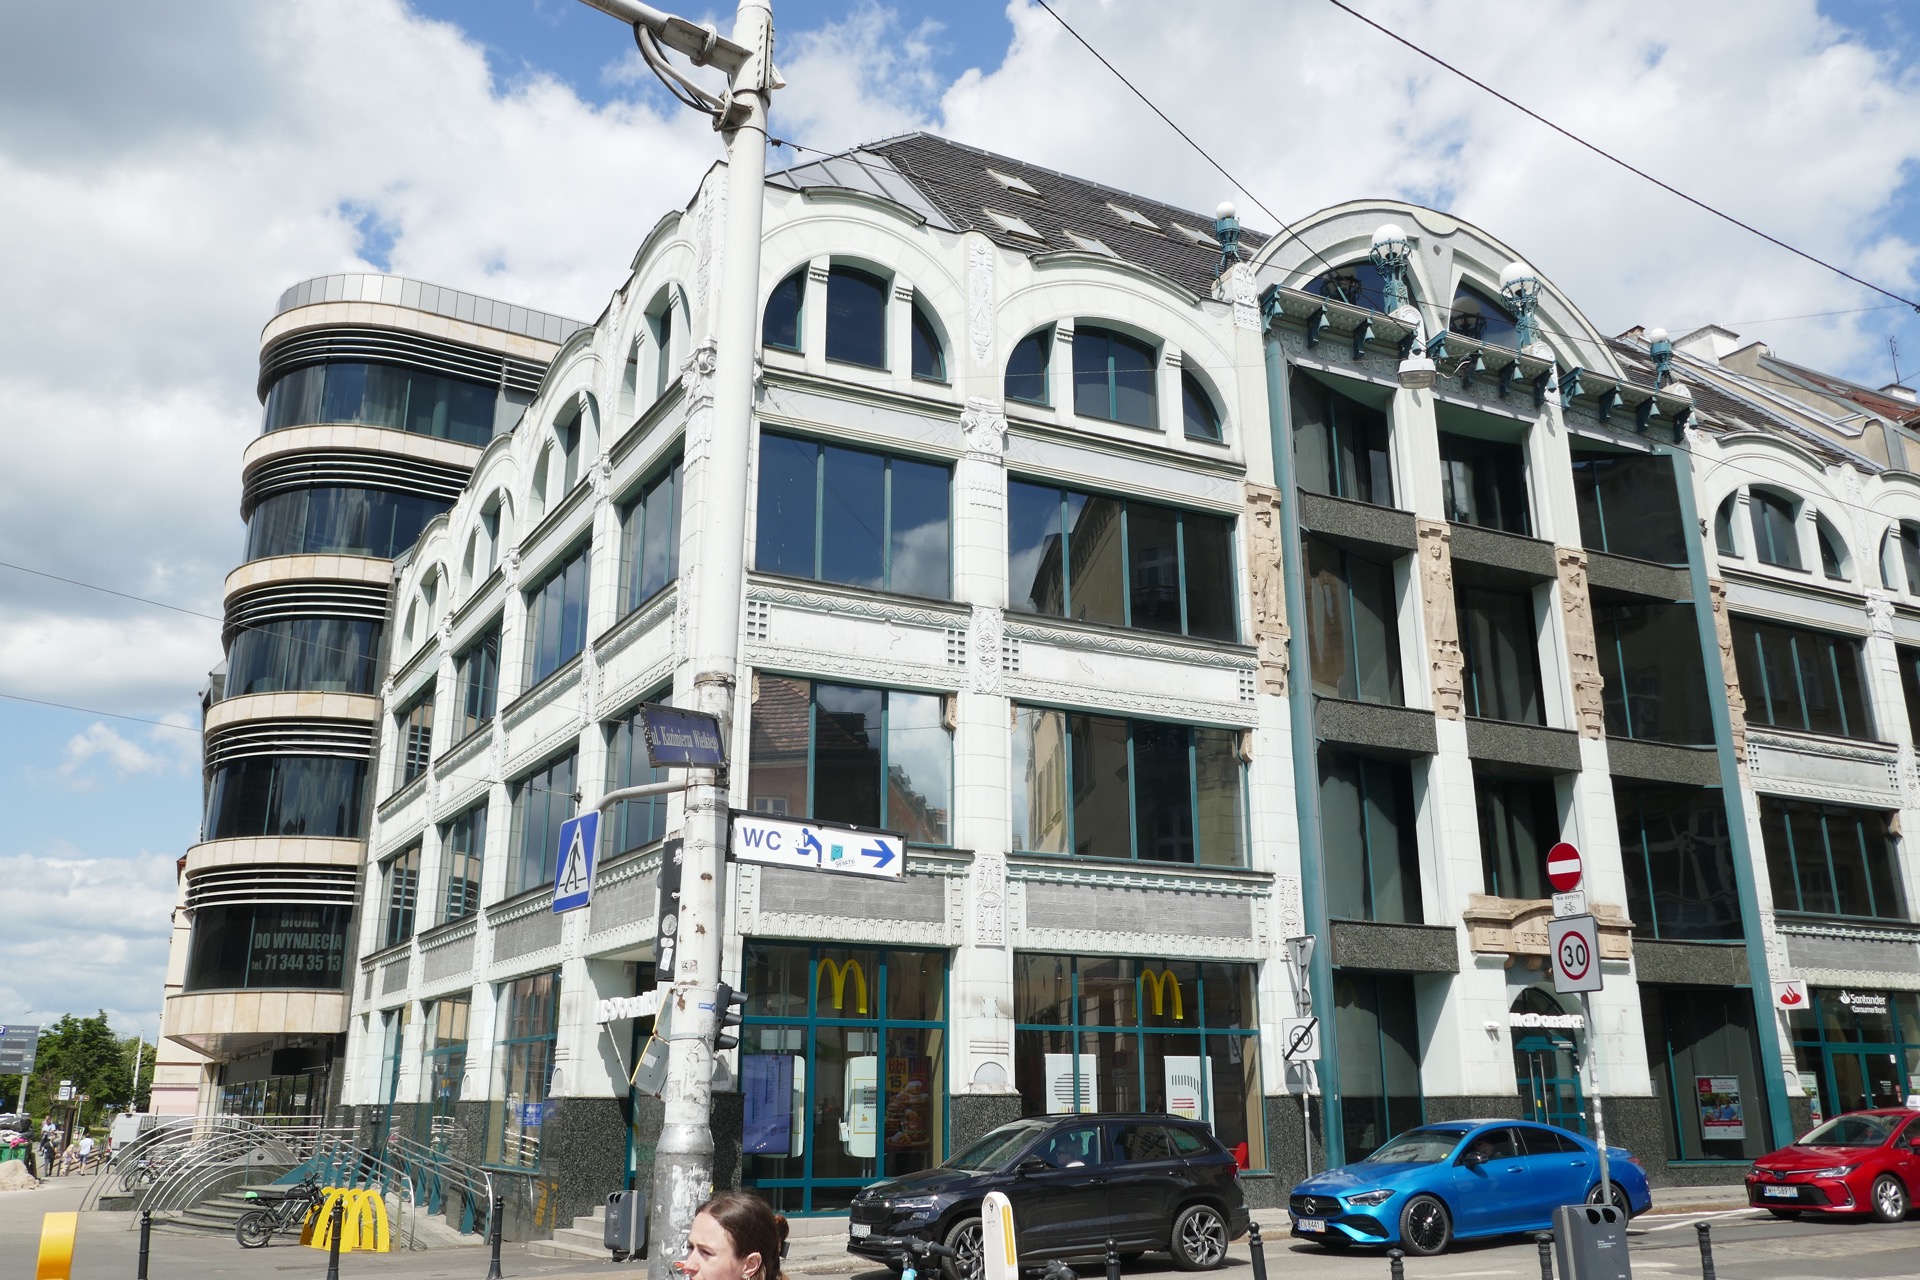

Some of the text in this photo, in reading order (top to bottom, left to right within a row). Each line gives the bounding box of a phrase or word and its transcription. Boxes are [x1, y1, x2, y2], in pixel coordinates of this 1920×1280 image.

[651, 726, 719, 754] ul. Kazimierza Wielkiego
[743, 826, 782, 850] WC
[281, 912, 319, 928] BIURA
[254, 933, 343, 952] DO WYNAJĘCIA
[251, 954, 341, 972] tel. 71 344 35 13
[1563, 944, 1586, 968] 30
[1850, 993, 1886, 1005] Santander
